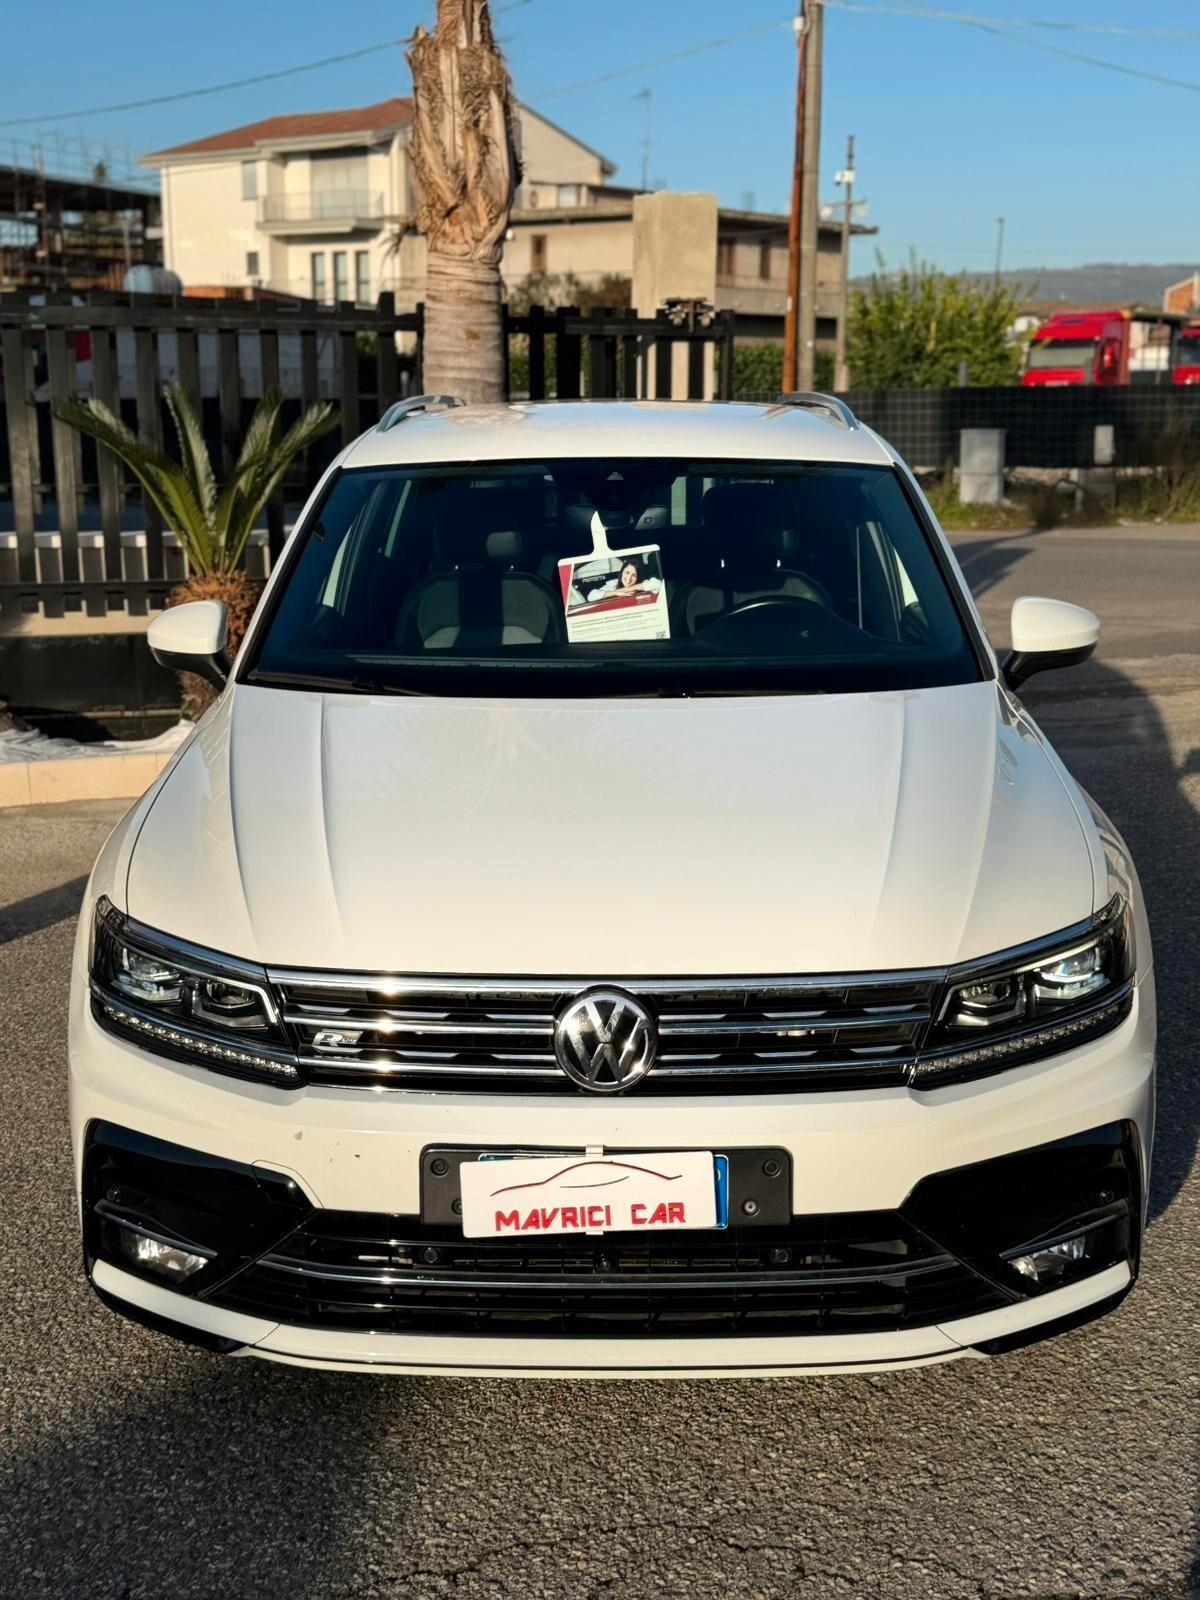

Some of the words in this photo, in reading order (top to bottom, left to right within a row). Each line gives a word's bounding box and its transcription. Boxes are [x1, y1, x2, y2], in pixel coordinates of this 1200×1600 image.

[557, 991, 652, 1088] VW
[495, 1205, 612, 1232] MAVRICI
[631, 1202, 687, 1225] CAR
